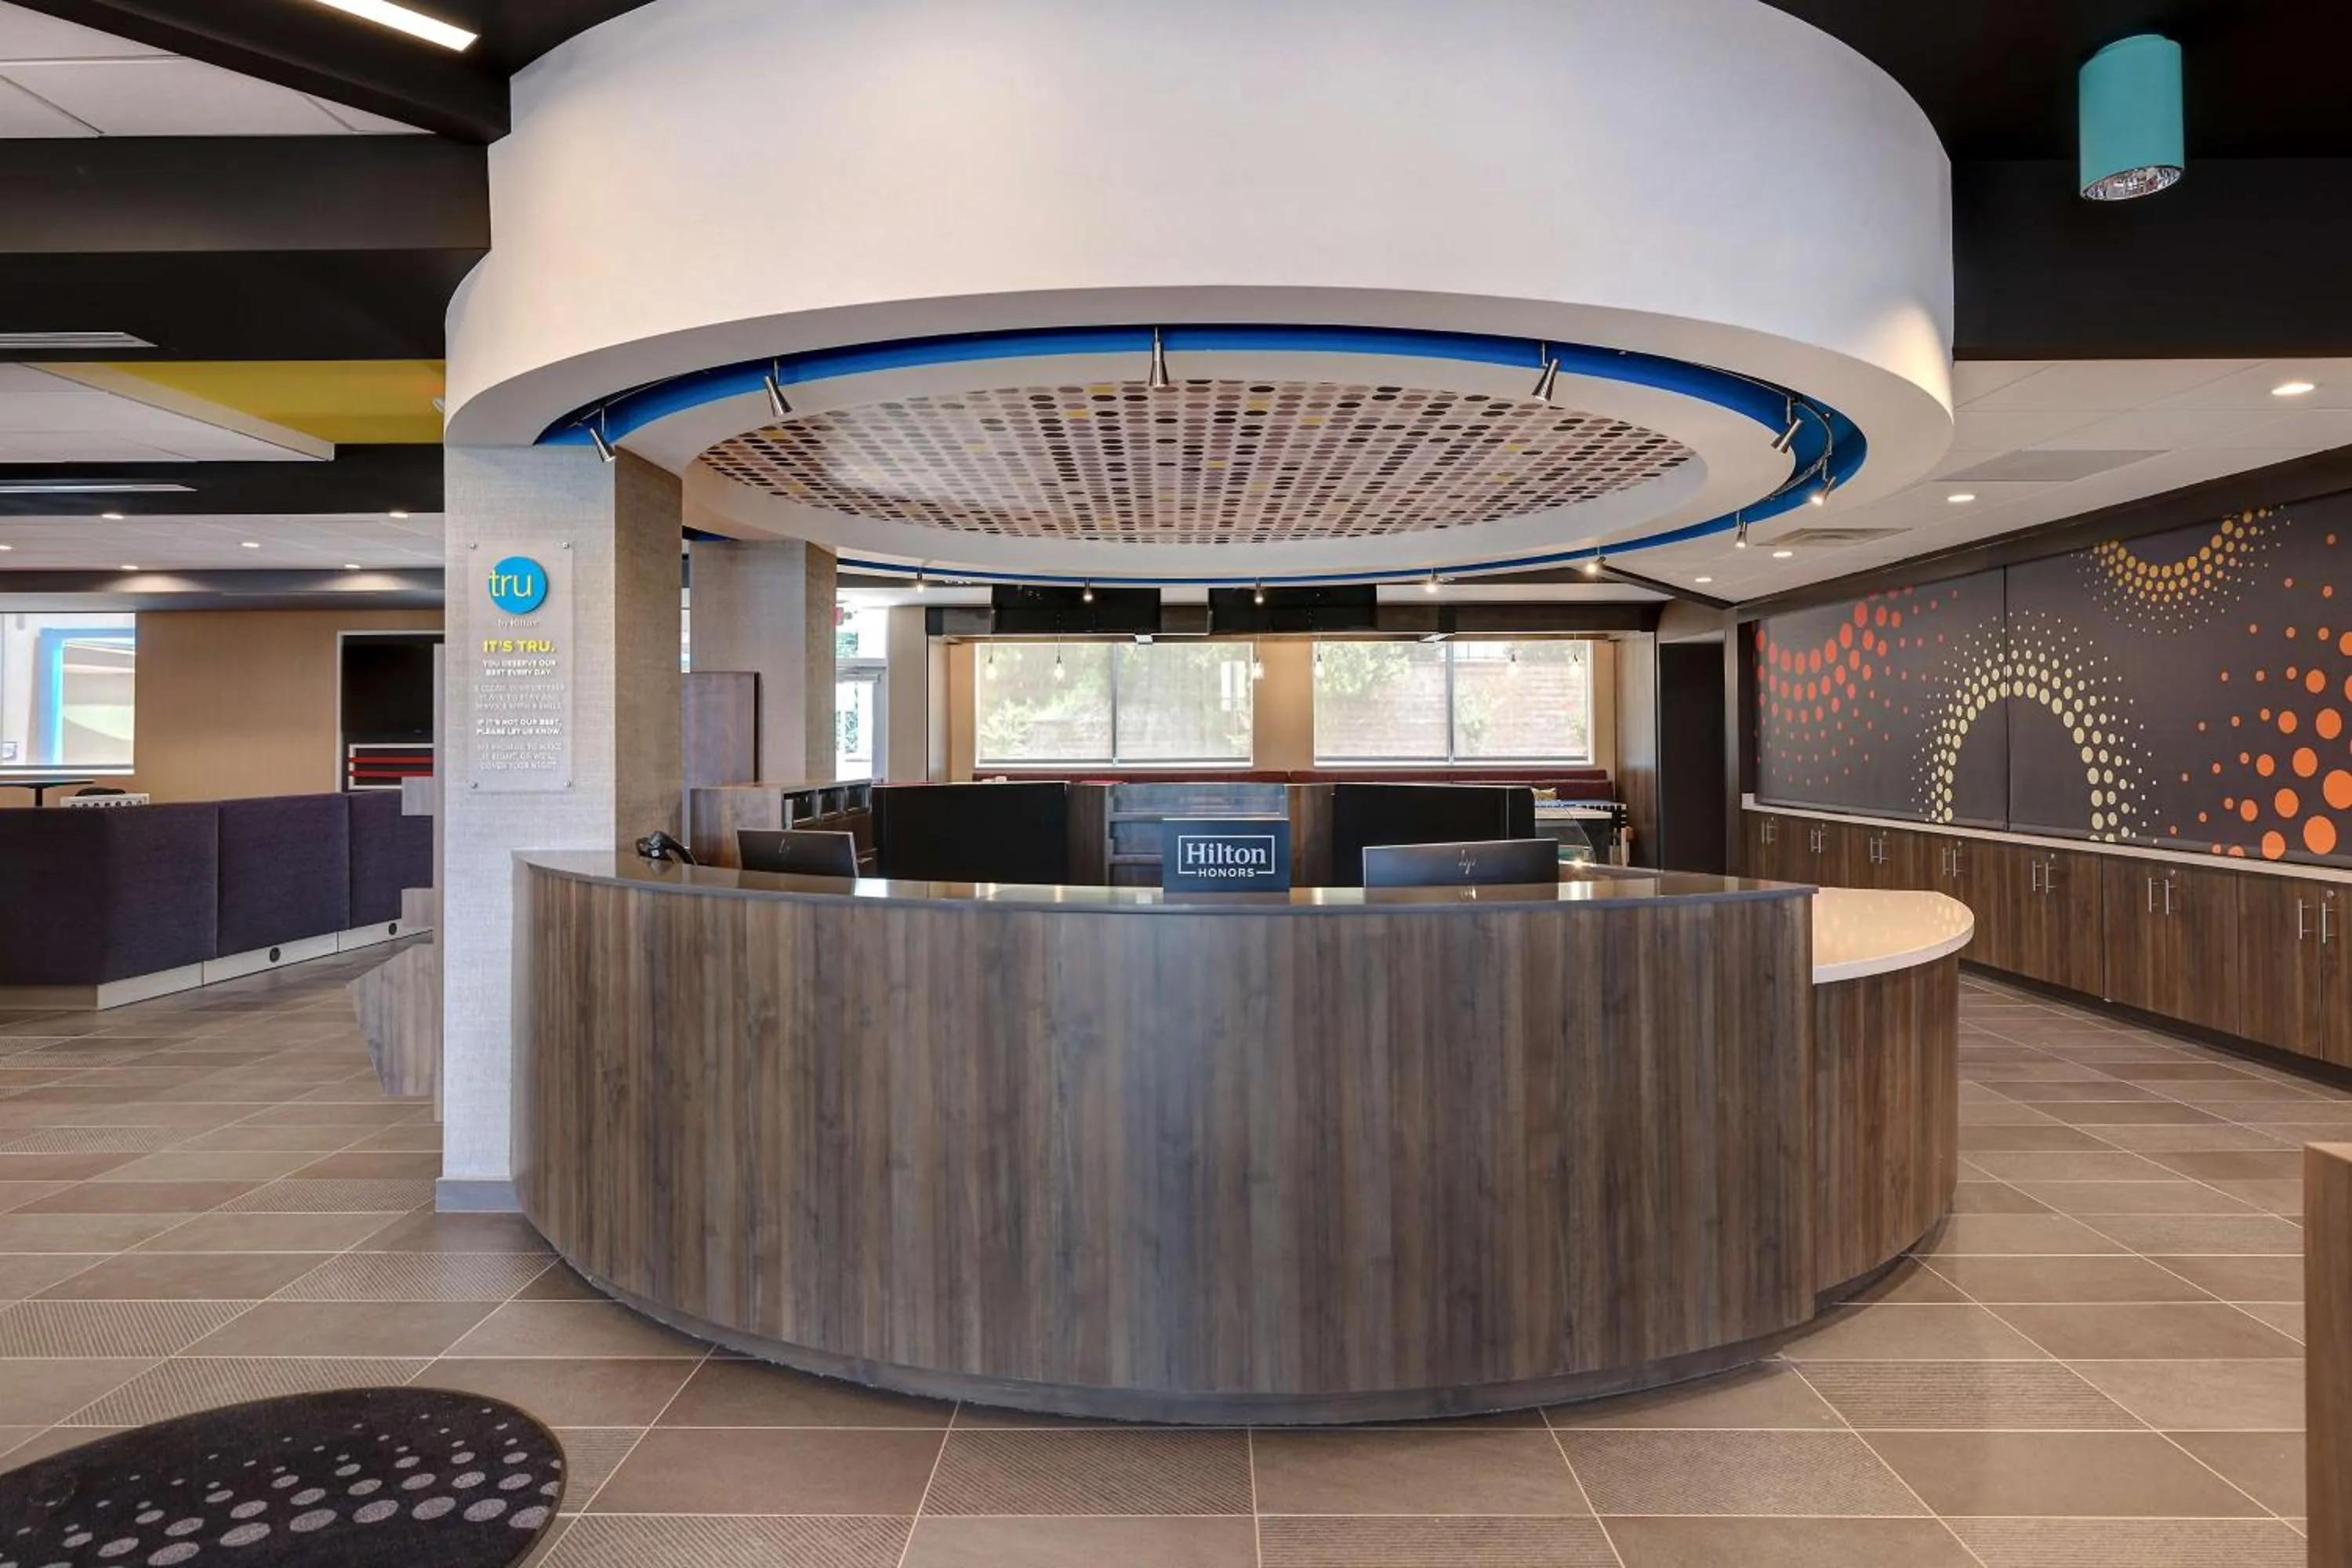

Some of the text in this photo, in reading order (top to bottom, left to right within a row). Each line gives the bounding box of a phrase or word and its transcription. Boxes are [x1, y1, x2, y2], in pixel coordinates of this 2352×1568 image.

[489, 569, 532, 597] tru
[483, 640, 514, 652] IT'S
[1186, 843, 1267, 865] Hilton
[1198, 869, 1255, 877] HONORS
